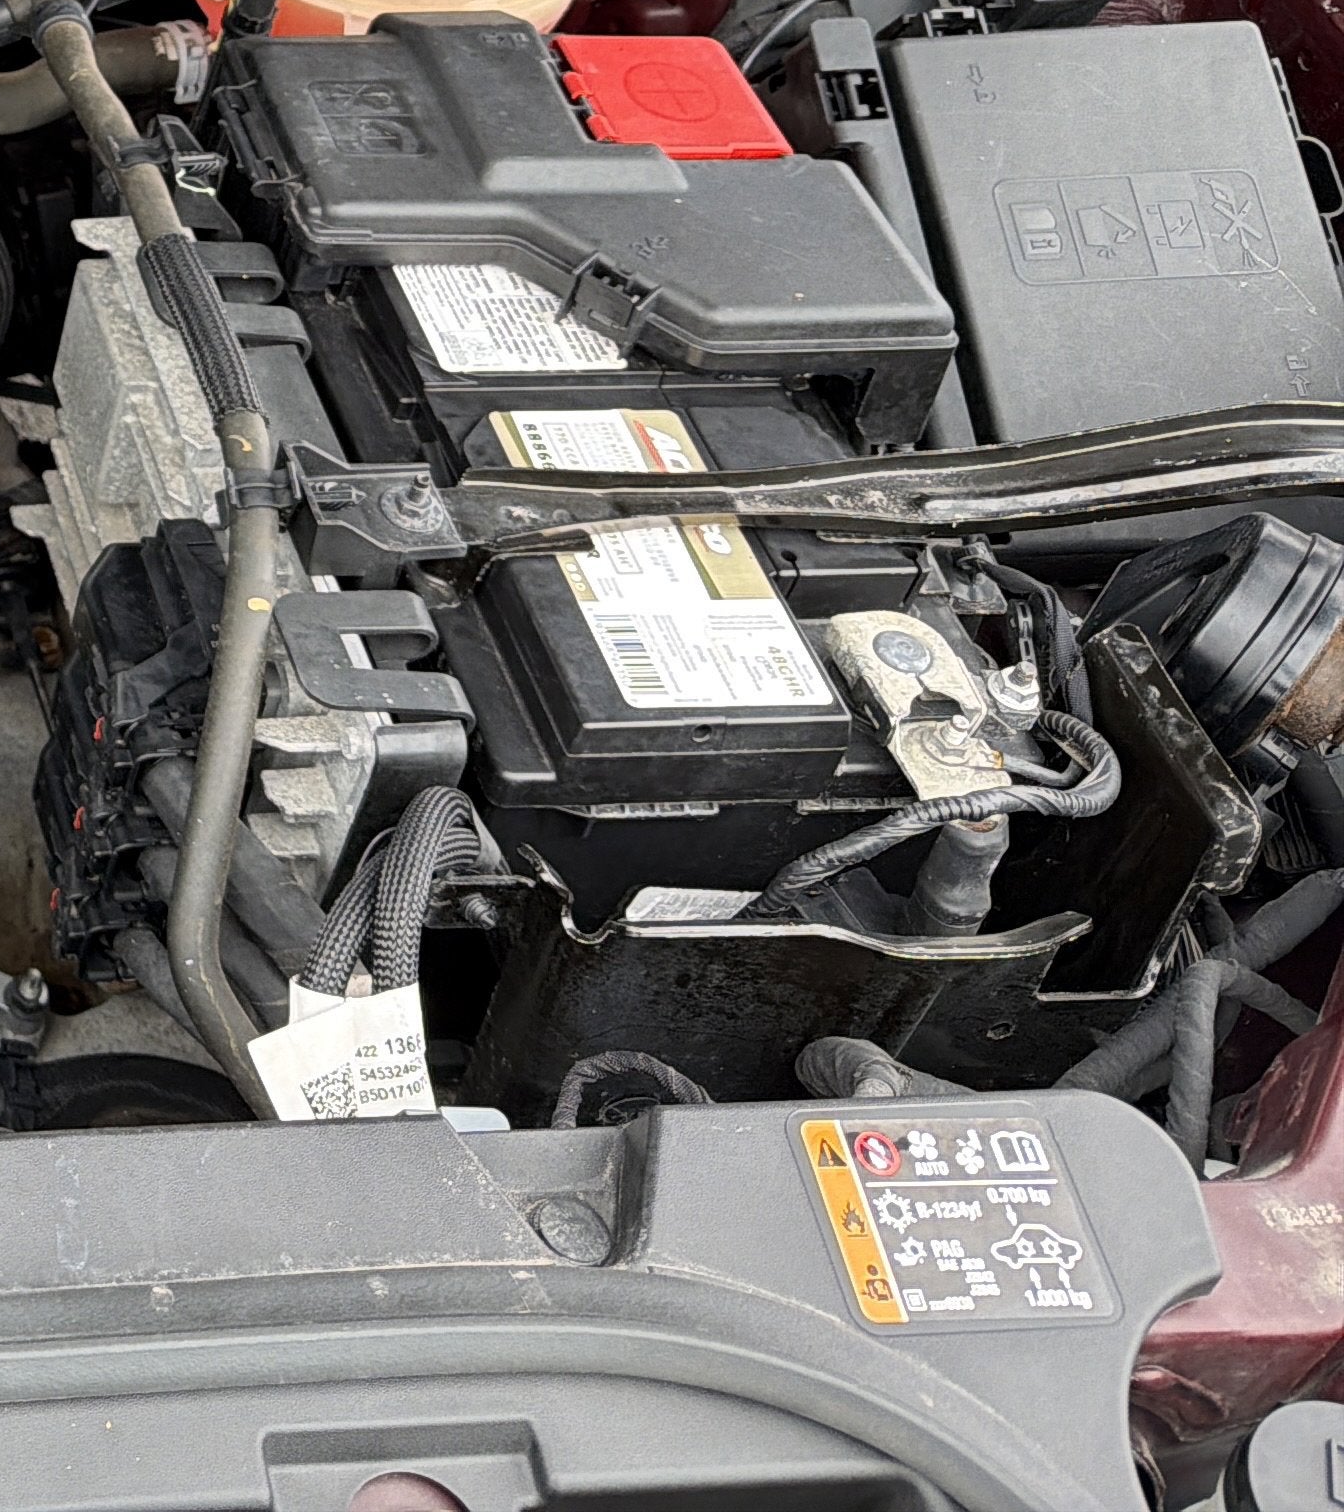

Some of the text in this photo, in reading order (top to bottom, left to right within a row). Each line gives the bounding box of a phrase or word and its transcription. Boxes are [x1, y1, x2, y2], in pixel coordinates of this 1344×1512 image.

[915, 1160, 950, 1175] AUTO
[1028, 1187, 1051, 1206] kg
[930, 1239, 965, 1258] PAG
[1067, 1290, 1093, 1309] kg
